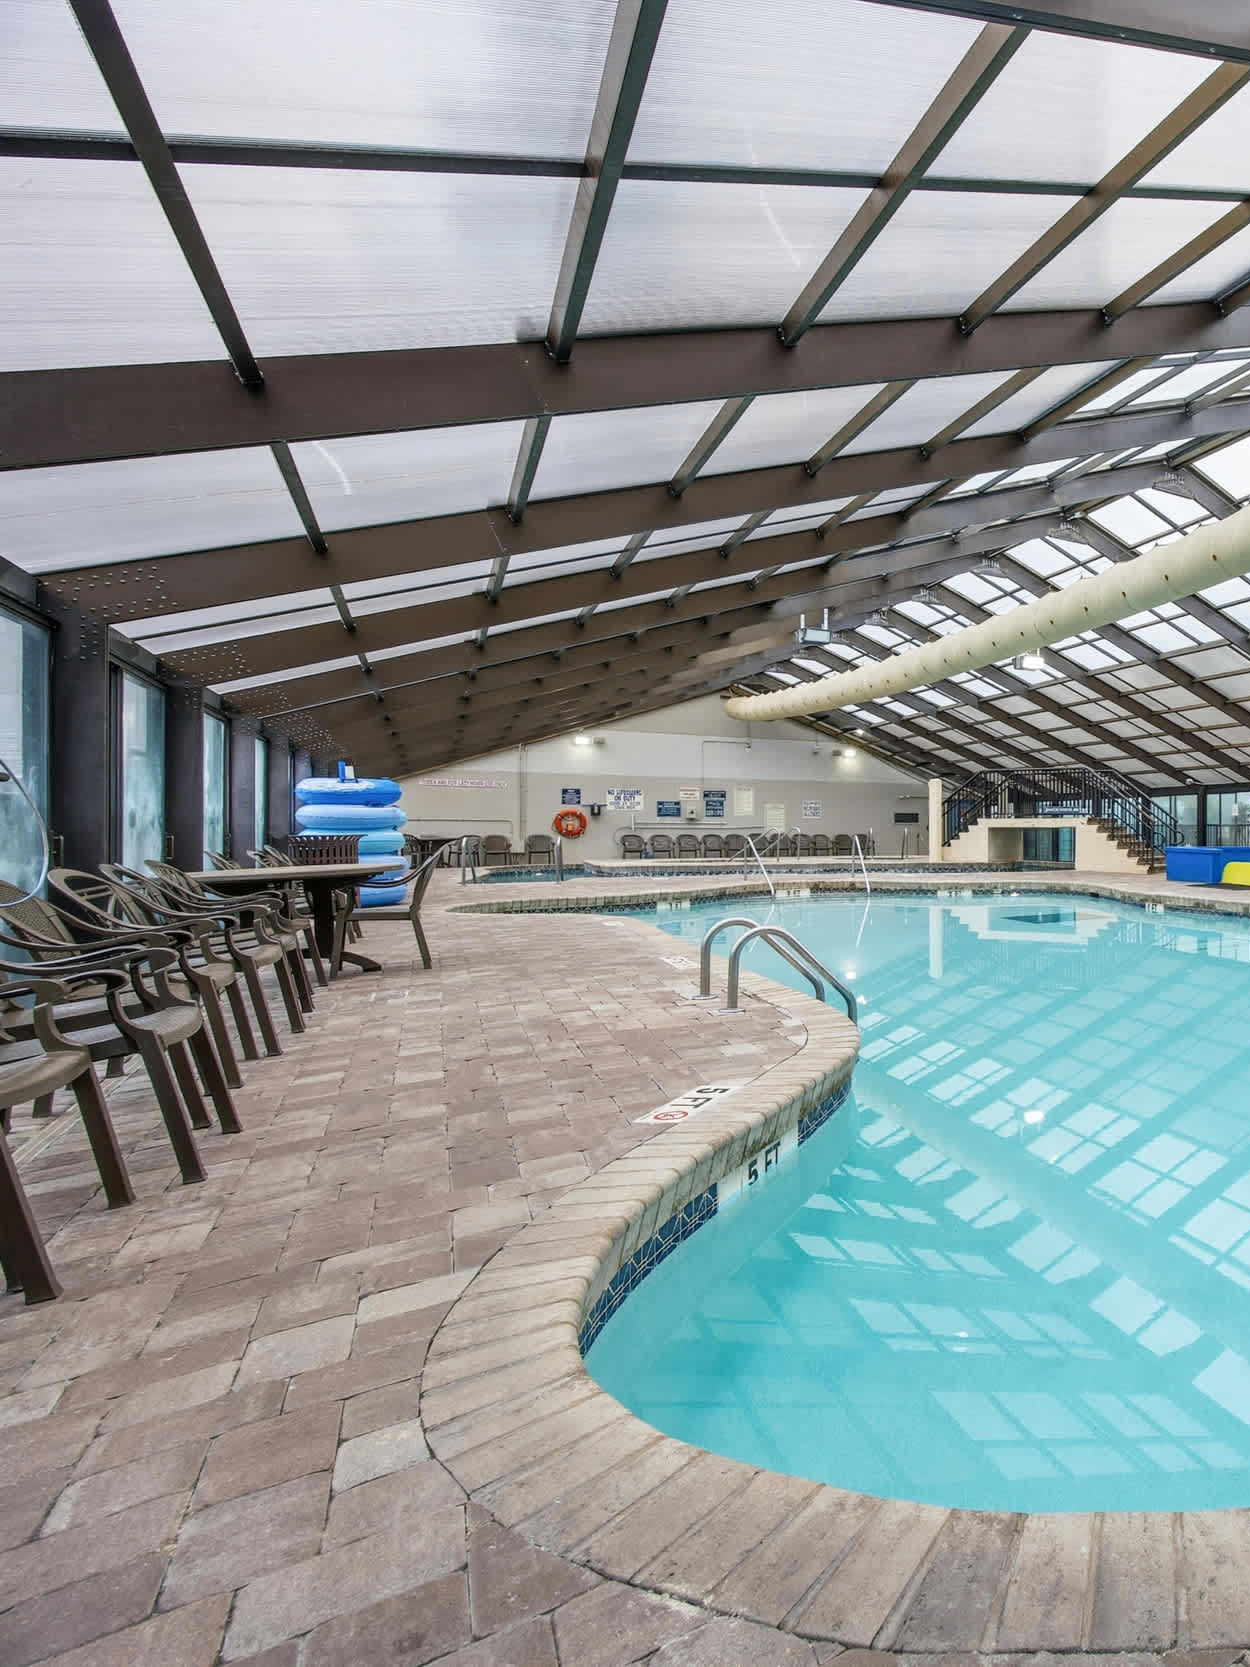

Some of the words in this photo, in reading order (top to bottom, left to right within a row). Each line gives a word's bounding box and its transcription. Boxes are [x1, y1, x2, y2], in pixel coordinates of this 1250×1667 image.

[670, 1096, 713, 1109] FT
[748, 1160, 759, 1186] 5
[765, 1141, 781, 1173] FT
